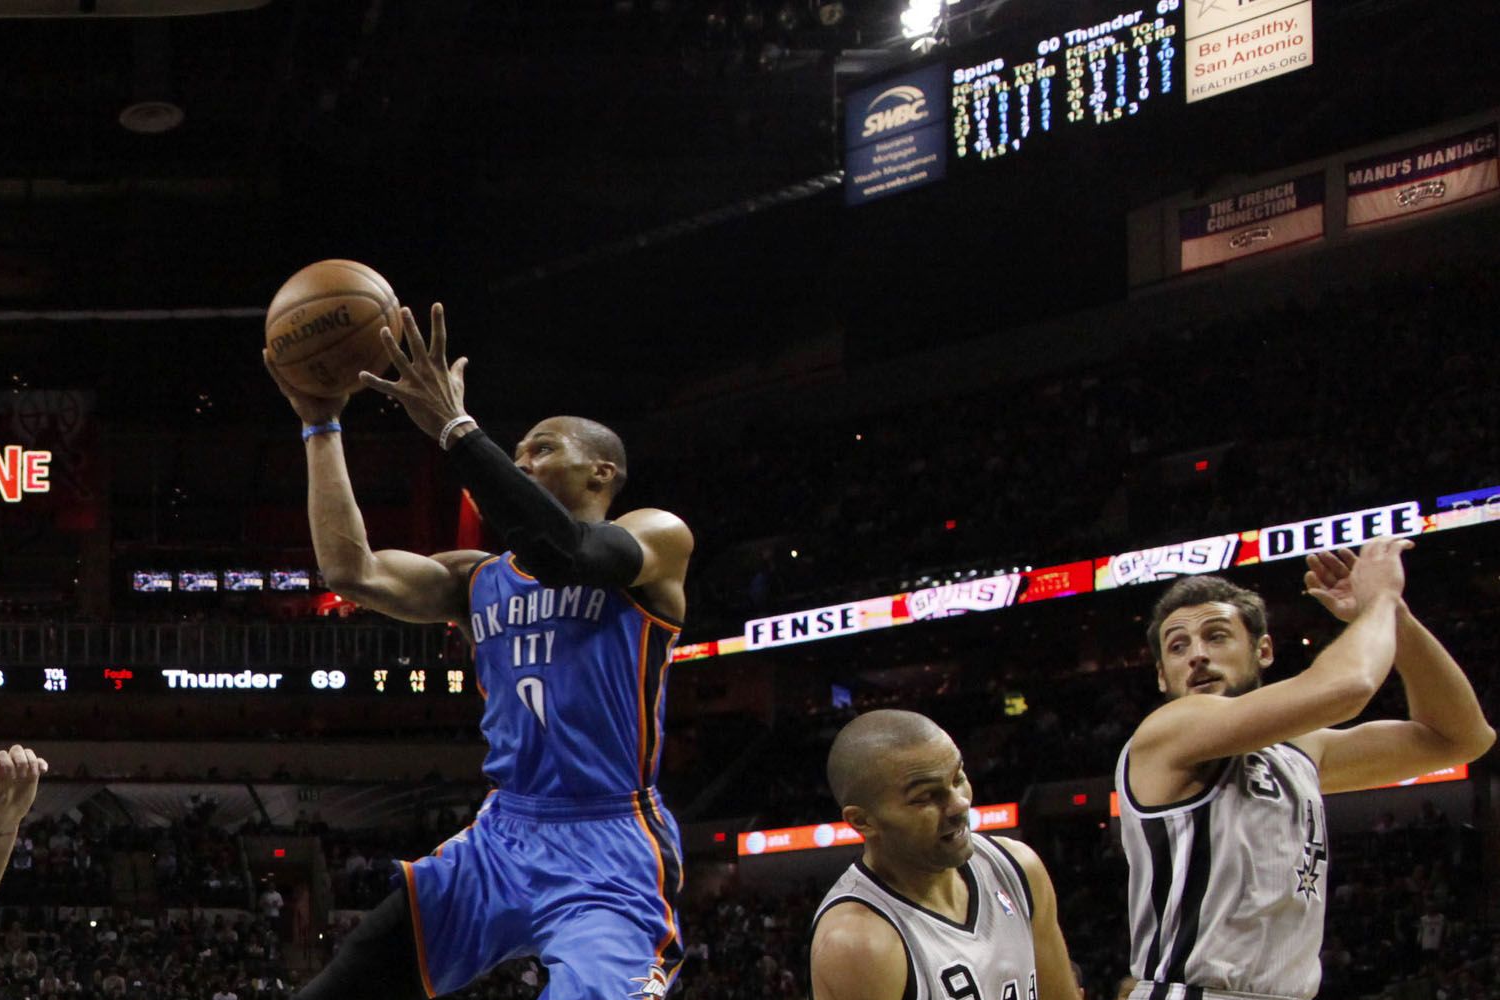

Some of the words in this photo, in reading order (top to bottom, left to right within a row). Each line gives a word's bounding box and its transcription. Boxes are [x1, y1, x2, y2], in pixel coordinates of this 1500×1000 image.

[1064, 10, 1143, 45] Thunder
[1157, 0, 1179, 14] 69
[1199, 42, 1221, 57] Be
[1227, 18, 1298, 48] Healthy,
[953, 58, 1004, 84] Spurs
[1038, 37, 1060, 55] 60
[1066, 57, 1084, 70] PL
[1089, 48, 1107, 62] PT
[1112, 42, 1128, 55] FL
[1132, 33, 1153, 48] AS
[1155, 25, 1176, 41] RB
[1090, 59, 1106, 73] 13
[1140, 46, 1147, 56] 1
[1157, 48, 1174, 60] 10
[1194, 59, 1227, 78] San
[1232, 34, 1304, 65] Antonio
[1014, 73, 1033, 87] AS
[1191, 52, 1308, 96] HEALTHTEXAS.ORG
[862, 99, 928, 138] SWBC
[1349, 160, 1411, 185] MANU'S
[1206, 195, 1297, 232] CONNECTION
[1209, 199, 1235, 217] THE
[1238, 181, 1295, 209] FRENCH
[1267, 505, 1414, 557] DEEEE
[471, 585, 606, 644] OKAHOMA
[751, 606, 855, 646] FENSE
[512, 630, 556, 667] ITY
[44, 668, 66, 680] TOL
[162, 669, 283, 689] Thunder
[310, 669, 346, 689] 69
[44, 680, 66, 691] 4:1
[373, 670, 389, 681] ST
[409, 670, 426, 681] AS
[447, 670, 464, 681] RB
[1245, 753, 1282, 801] 3
